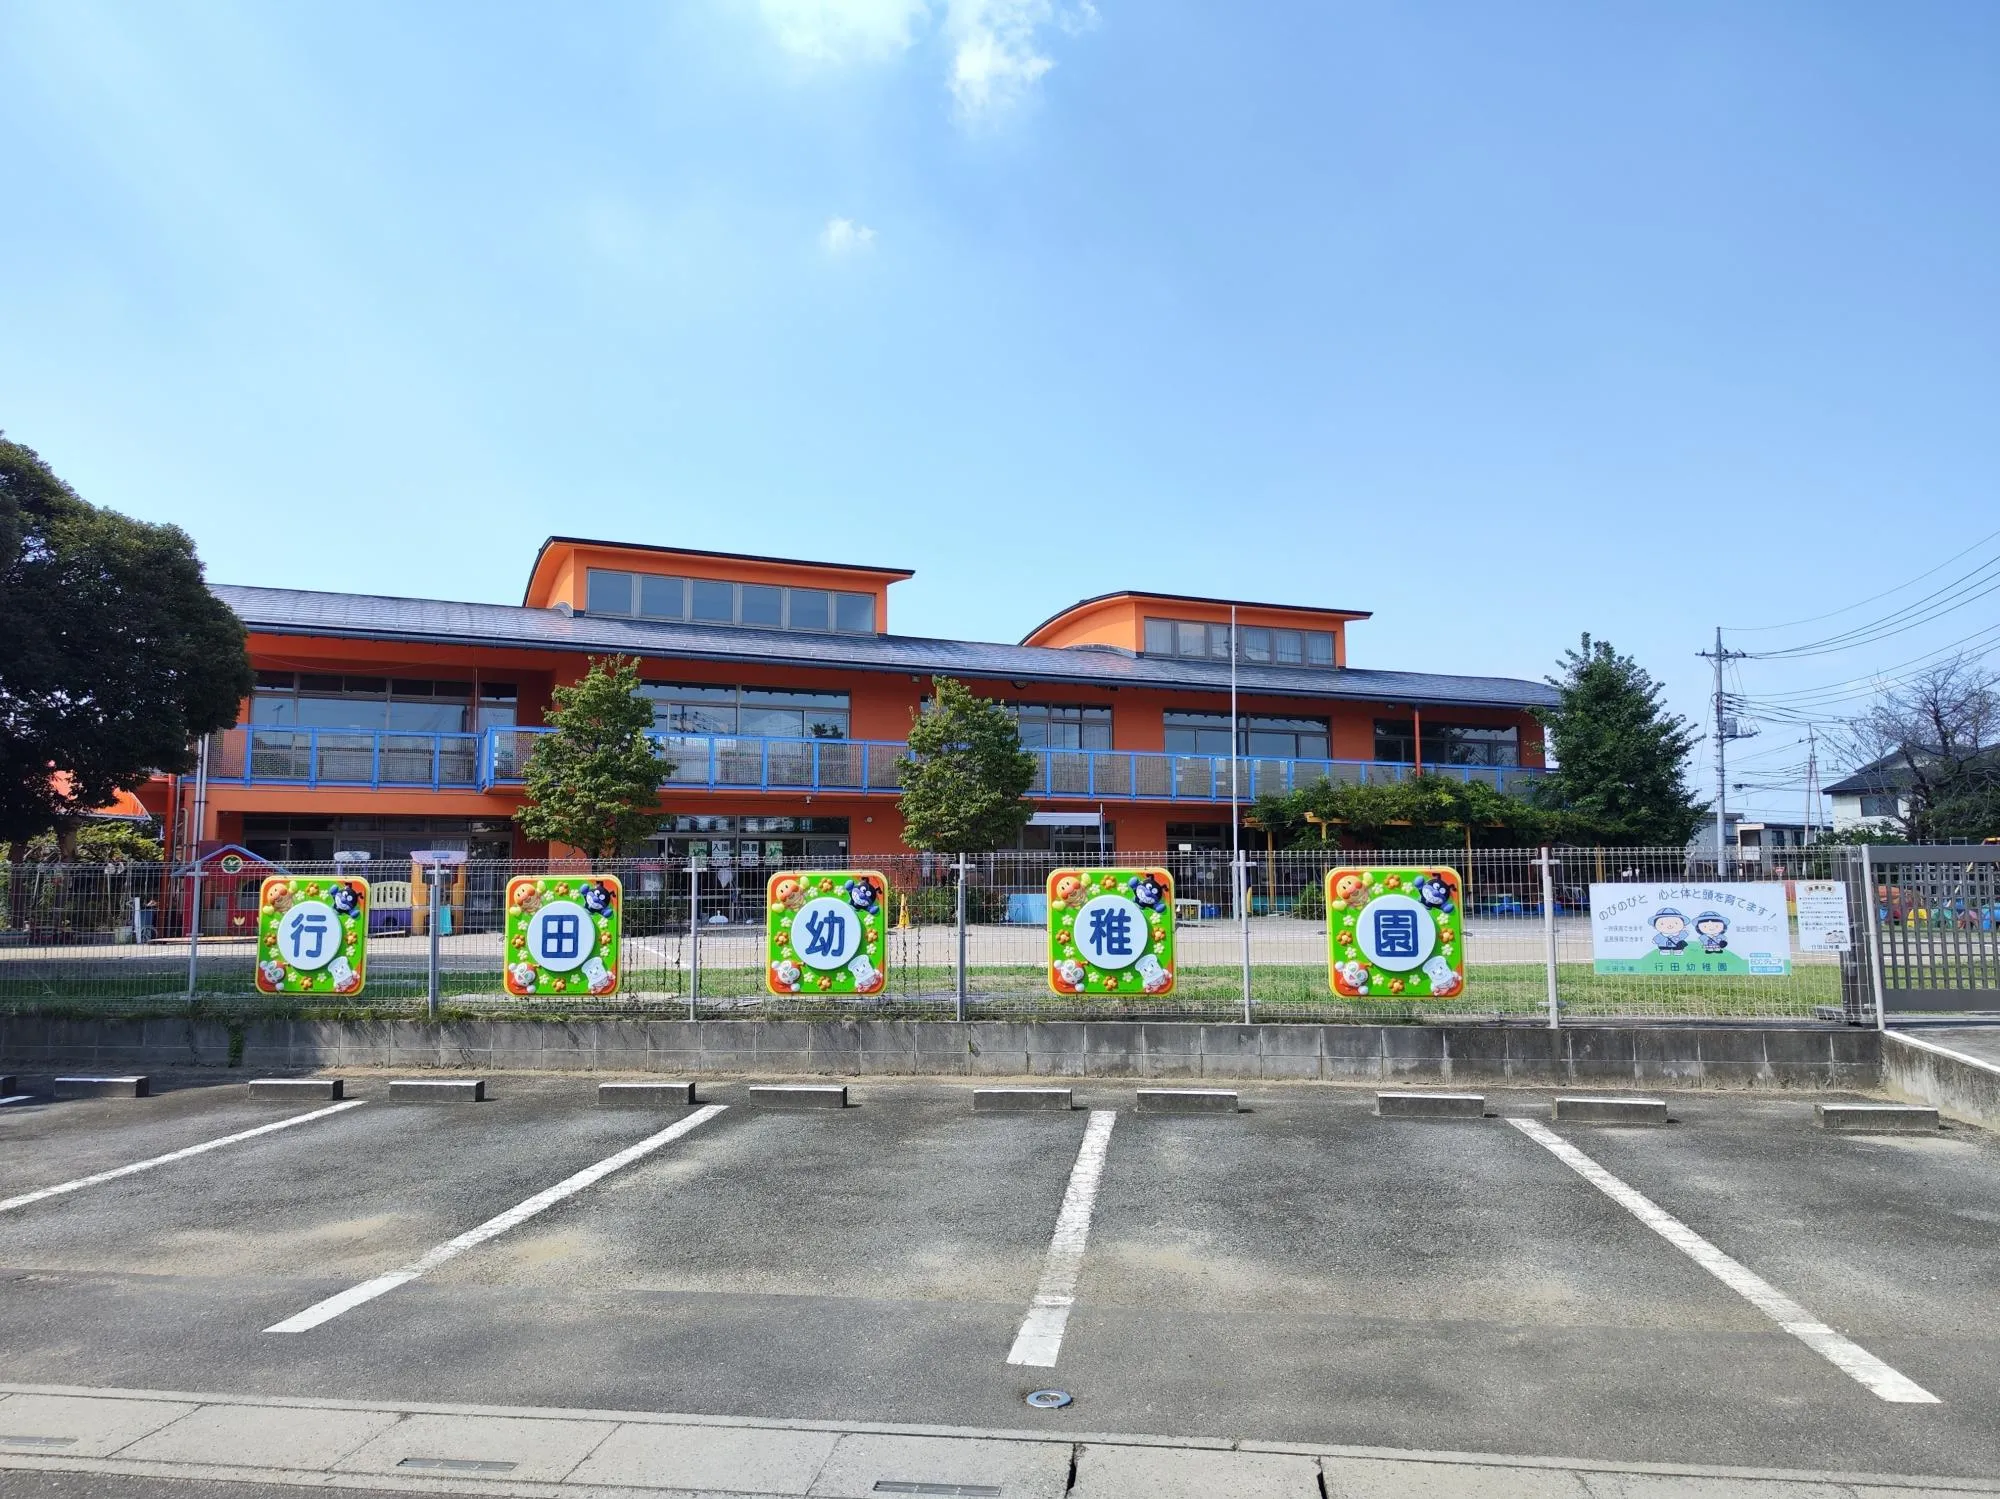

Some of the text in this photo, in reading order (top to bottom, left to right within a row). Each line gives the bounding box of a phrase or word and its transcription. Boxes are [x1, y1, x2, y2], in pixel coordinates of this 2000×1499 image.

[1599, 887, 1777, 921] のびのびと 心と体と頭を育てます！
[290, 913, 328, 958] 行
[541, 914, 580, 958] 田
[805, 910, 845, 957] 幼
[1089, 907, 1133, 956] 稚
[1373, 909, 1419, 957] 園
[1654, 962, 1728, 972] 行田幼稚園
